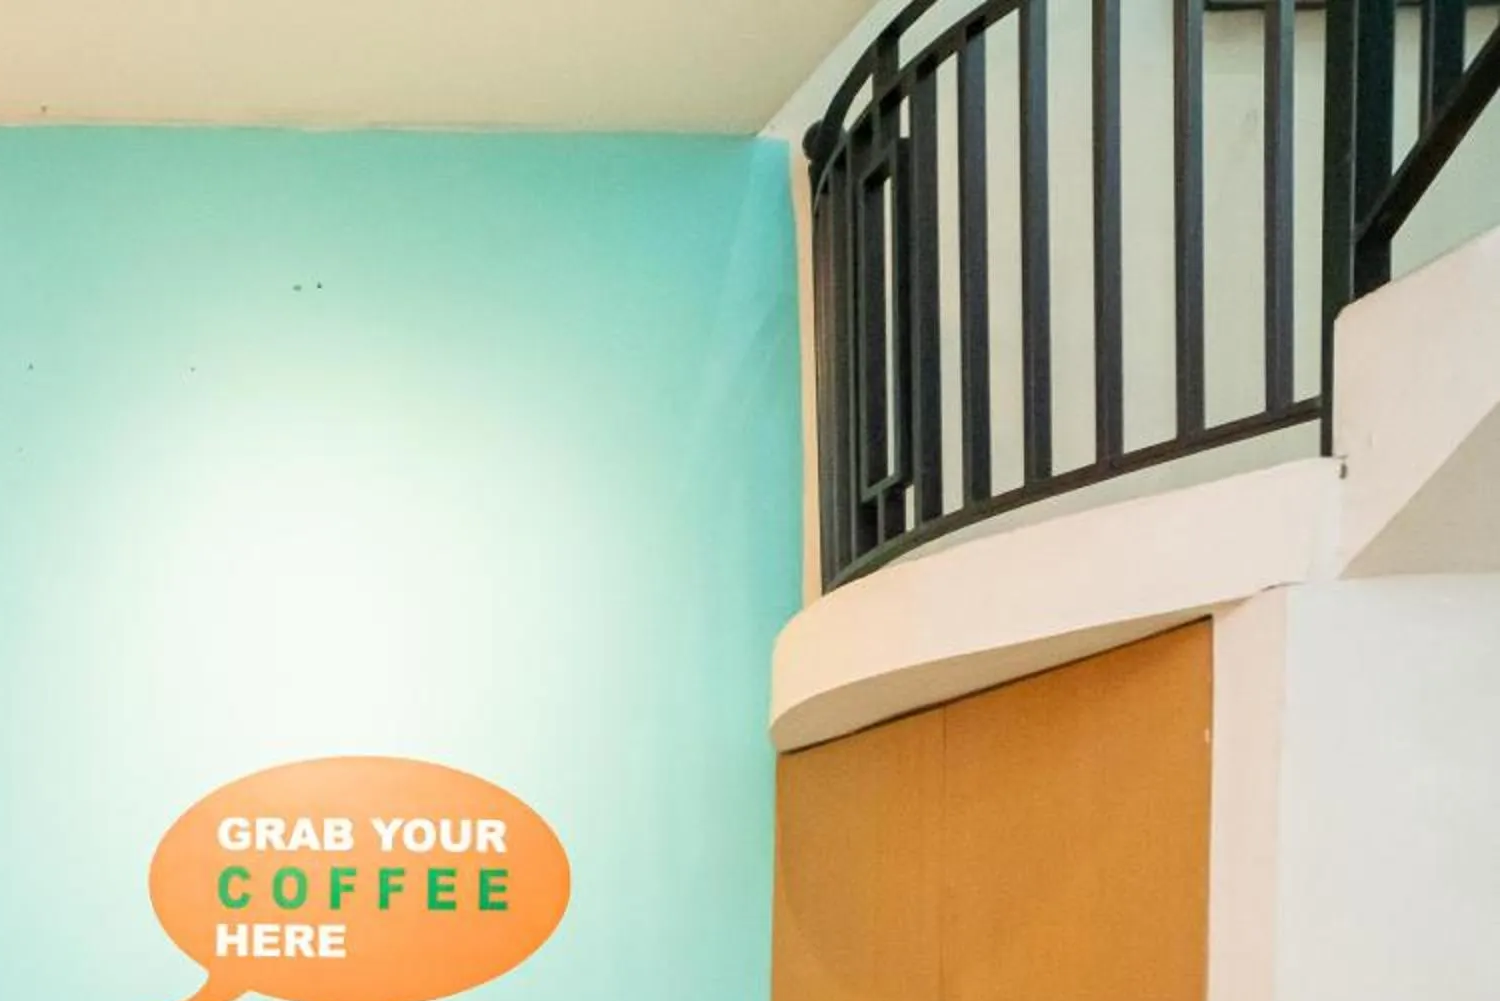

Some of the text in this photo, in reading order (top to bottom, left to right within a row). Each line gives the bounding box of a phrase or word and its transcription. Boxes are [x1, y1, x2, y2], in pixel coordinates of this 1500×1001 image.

[217, 817, 507, 852] GRAB YOUR
[217, 866, 509, 910] COFFEE
[215, 923, 347, 958] HERE
